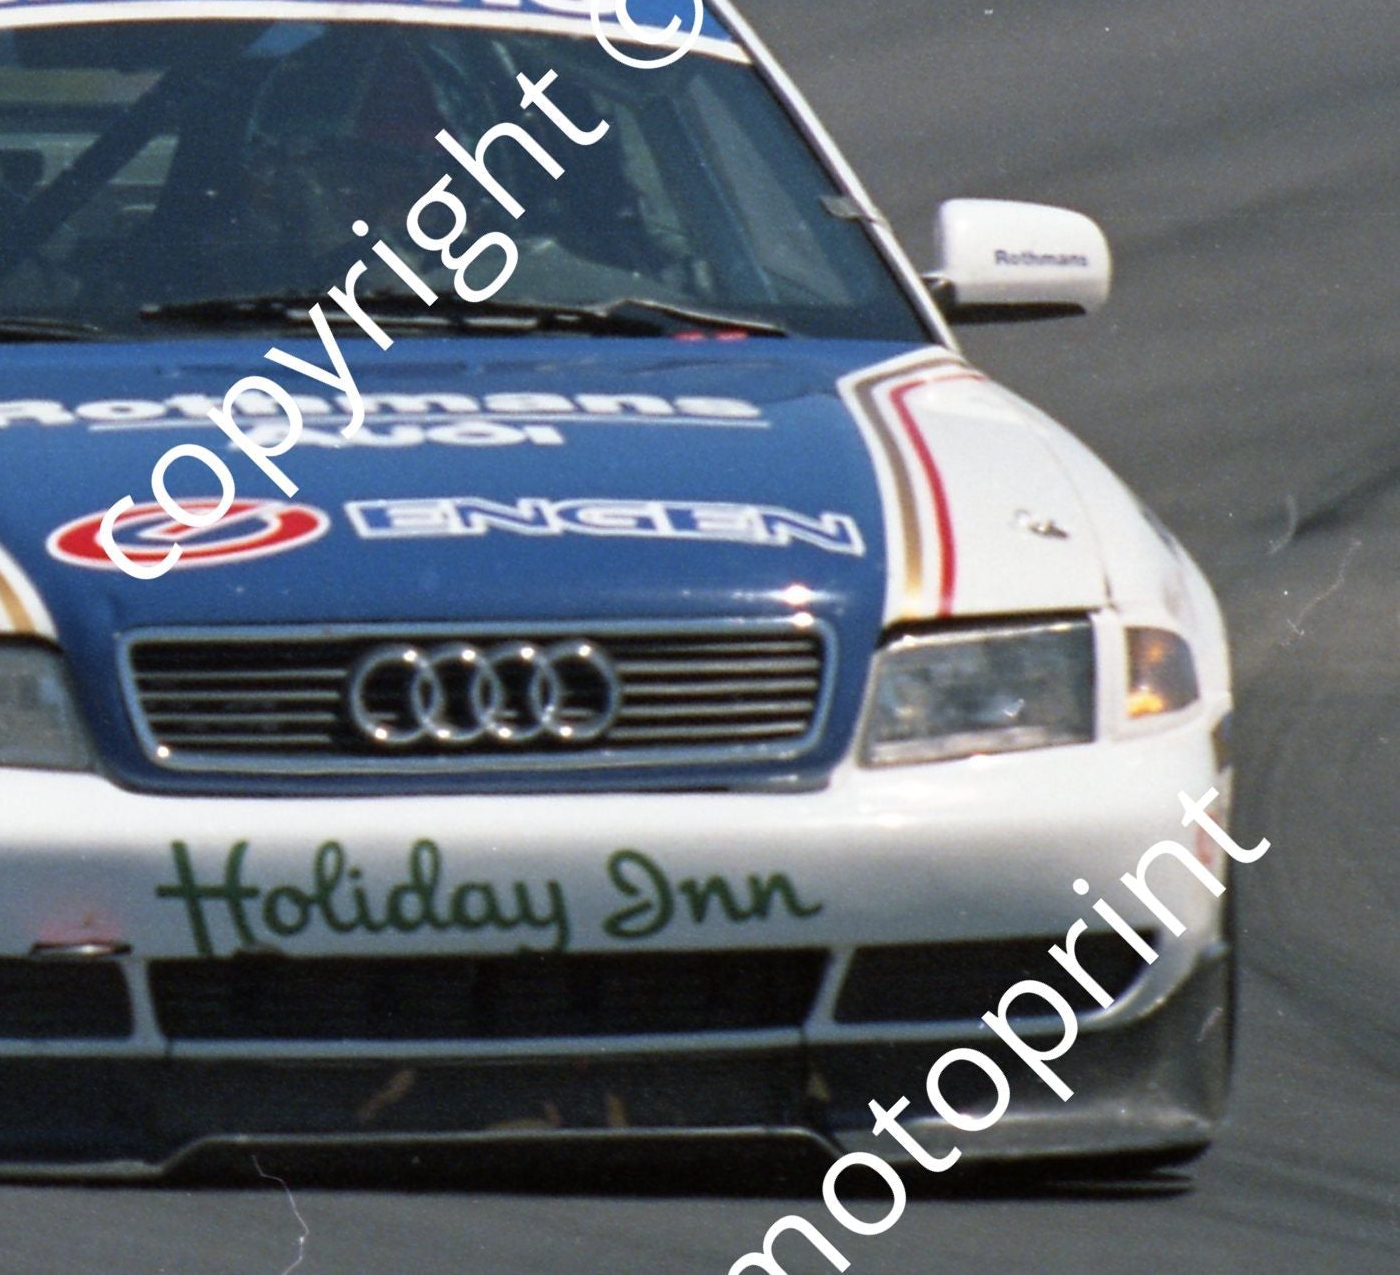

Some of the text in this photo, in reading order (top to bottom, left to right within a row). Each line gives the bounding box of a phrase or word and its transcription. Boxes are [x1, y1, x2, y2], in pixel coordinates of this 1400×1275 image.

[993, 249, 1089, 267] Rothmans
[346, 496, 865, 557] ENGEN
[155, 838, 824, 958] Holiday Inn
